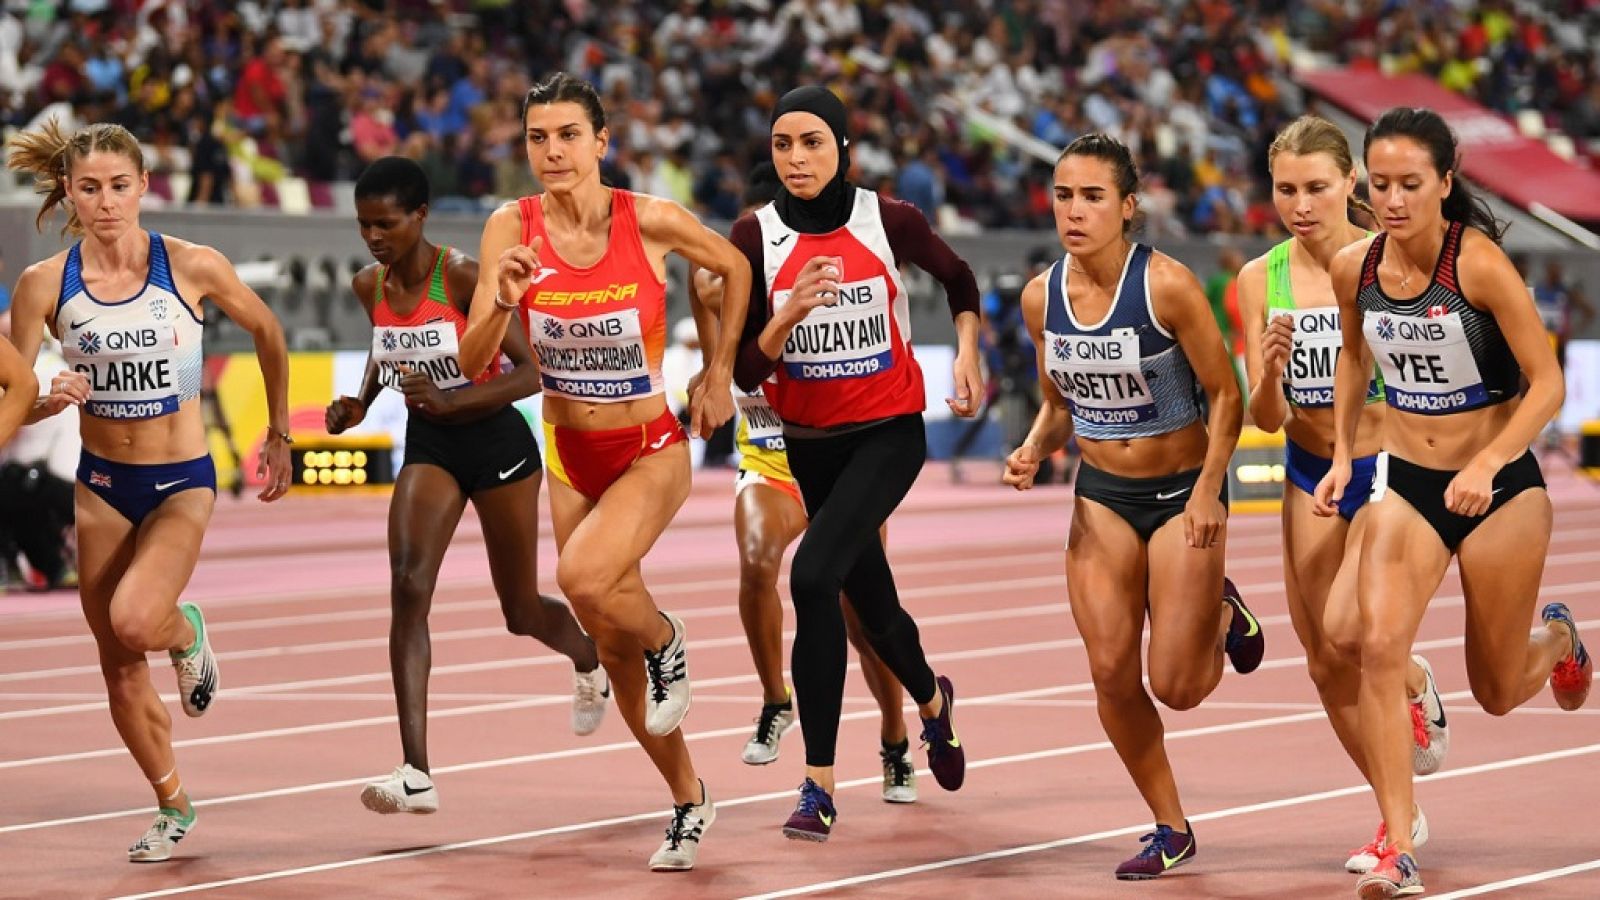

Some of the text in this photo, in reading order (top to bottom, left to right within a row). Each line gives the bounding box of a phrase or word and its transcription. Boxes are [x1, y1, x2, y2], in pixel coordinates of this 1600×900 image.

[533, 282, 638, 306] ESPAÑA
[821, 286, 873, 308] NB
[569, 318, 623, 338] QNB
[1300, 313, 1342, 333] QN
[1399, 321, 1446, 341] QNB
[106, 329, 158, 350] QNB
[399, 330, 441, 349] QNB
[785, 313, 887, 354] BOUZAYANI
[1076, 341, 1123, 360] QNB
[380, 356, 461, 386] CHONO
[802, 358, 879, 378] DOHA2019
[1388, 352, 1449, 383] YEE
[556, 382, 632, 396] DOHA2019
[1050, 369, 1145, 400] CASETTA
[92, 402, 163, 418] DOHA2019
[1396, 391, 1467, 410] DOHA2019
